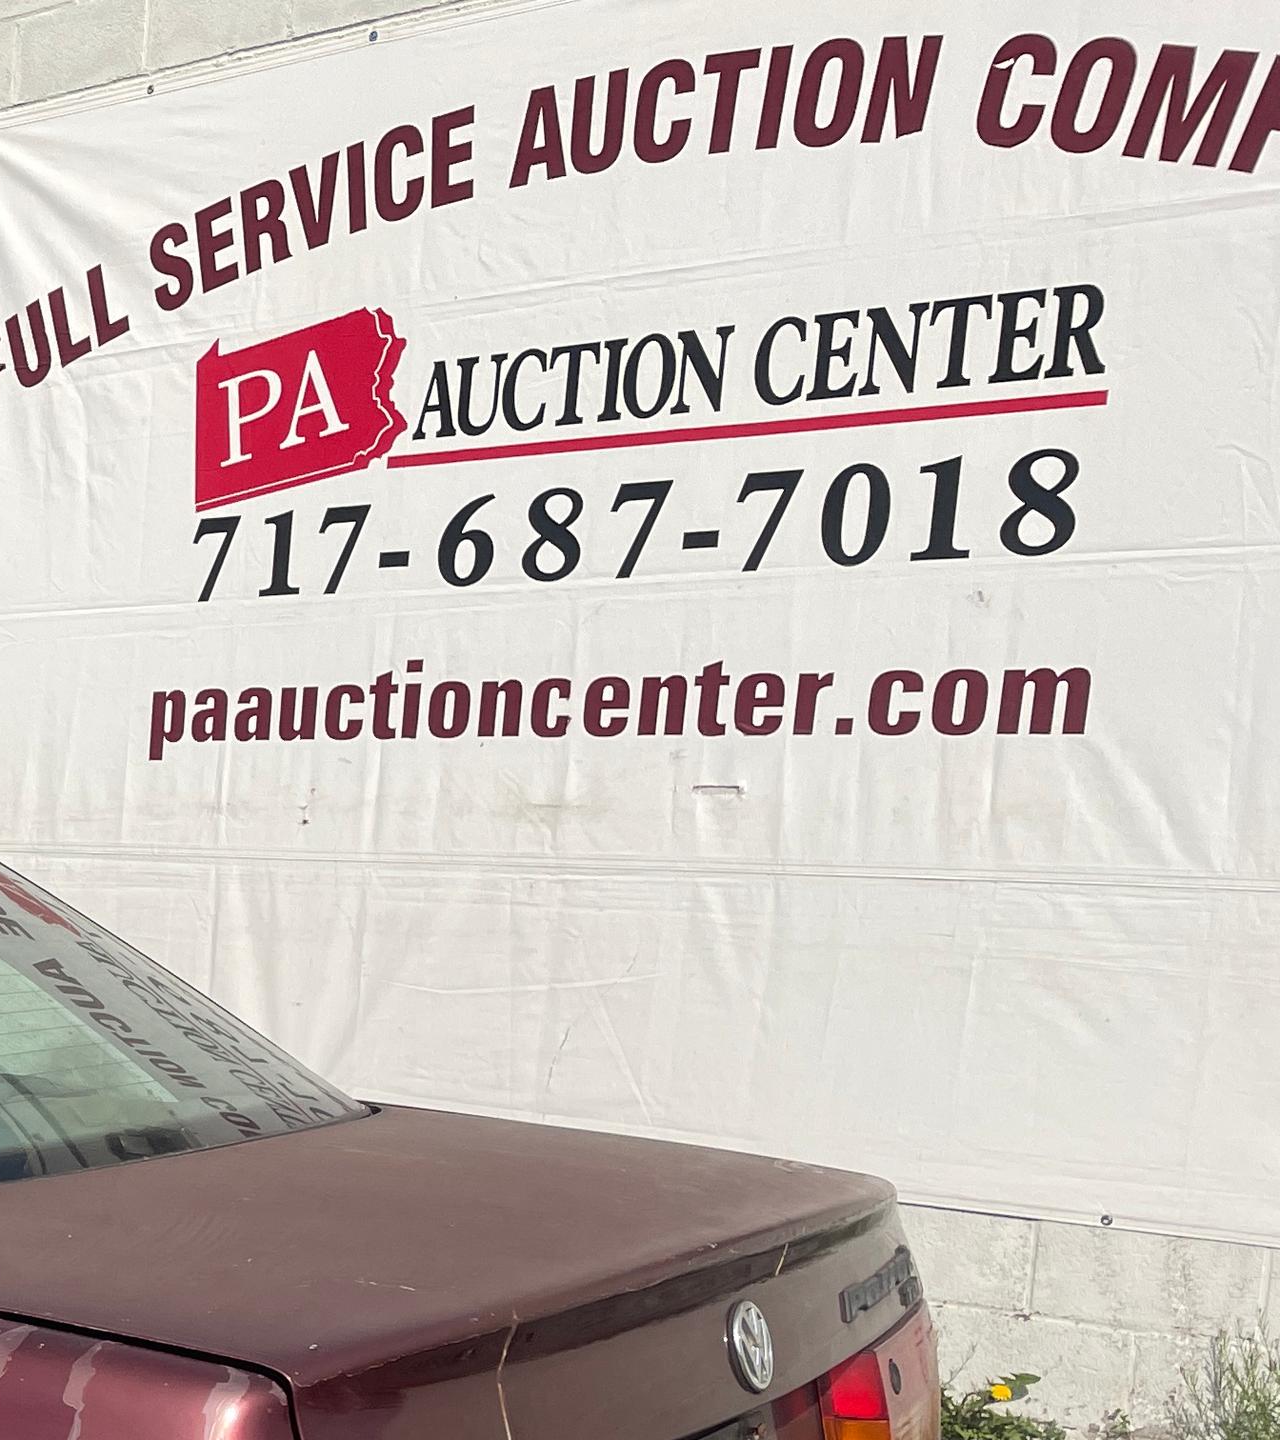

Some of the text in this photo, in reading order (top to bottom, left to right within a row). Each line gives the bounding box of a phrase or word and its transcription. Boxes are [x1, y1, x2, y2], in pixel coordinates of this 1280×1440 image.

[149, 106, 474, 311] SERVICE
[511, 35, 942, 188] AUCTION
[219, 284, 1106, 468] PA AUCTION CENTER
[193, 448, 1080, 603] 717-687-7018
[148, 659, 1091, 761] paauctioncenter.com
